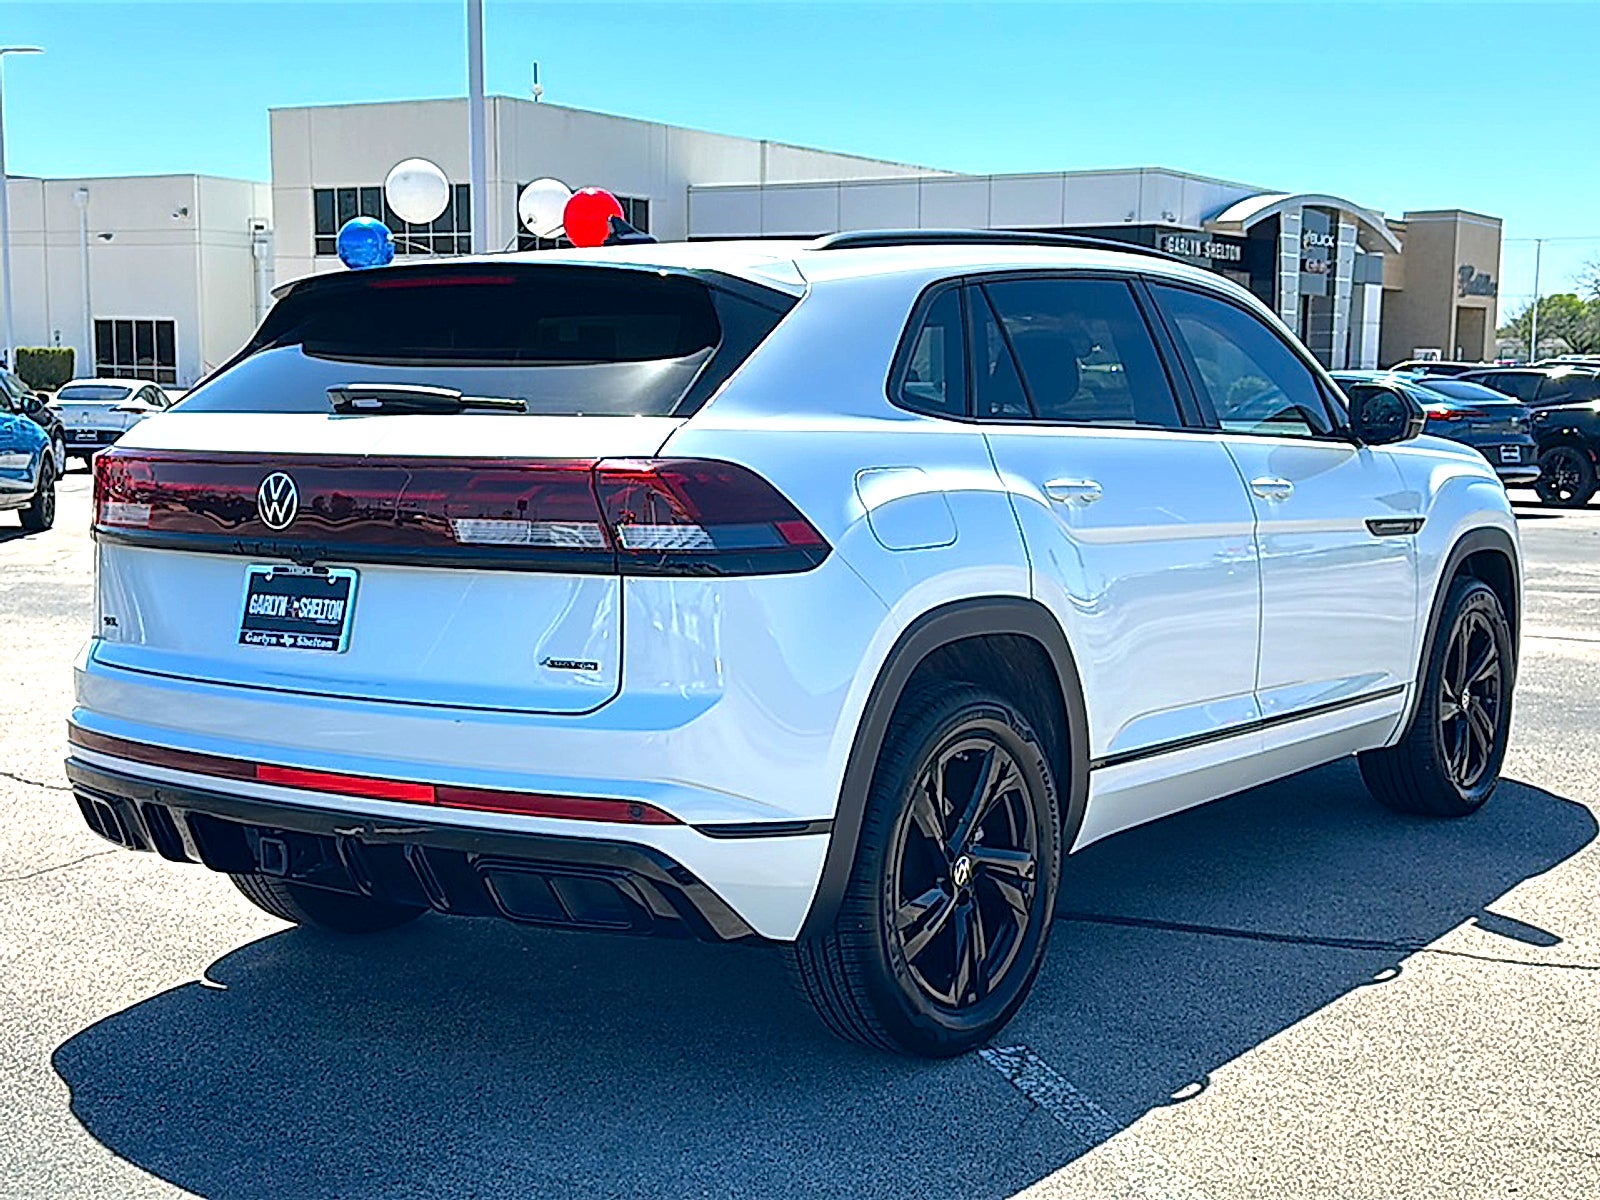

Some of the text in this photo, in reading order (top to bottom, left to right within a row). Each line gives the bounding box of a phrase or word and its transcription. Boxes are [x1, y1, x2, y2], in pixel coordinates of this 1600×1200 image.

[1203, 241, 1241, 261] SHELTON
[249, 594, 345, 620] GARLYN SHELTON
[245, 632, 333, 648] Garlyn Shelton
